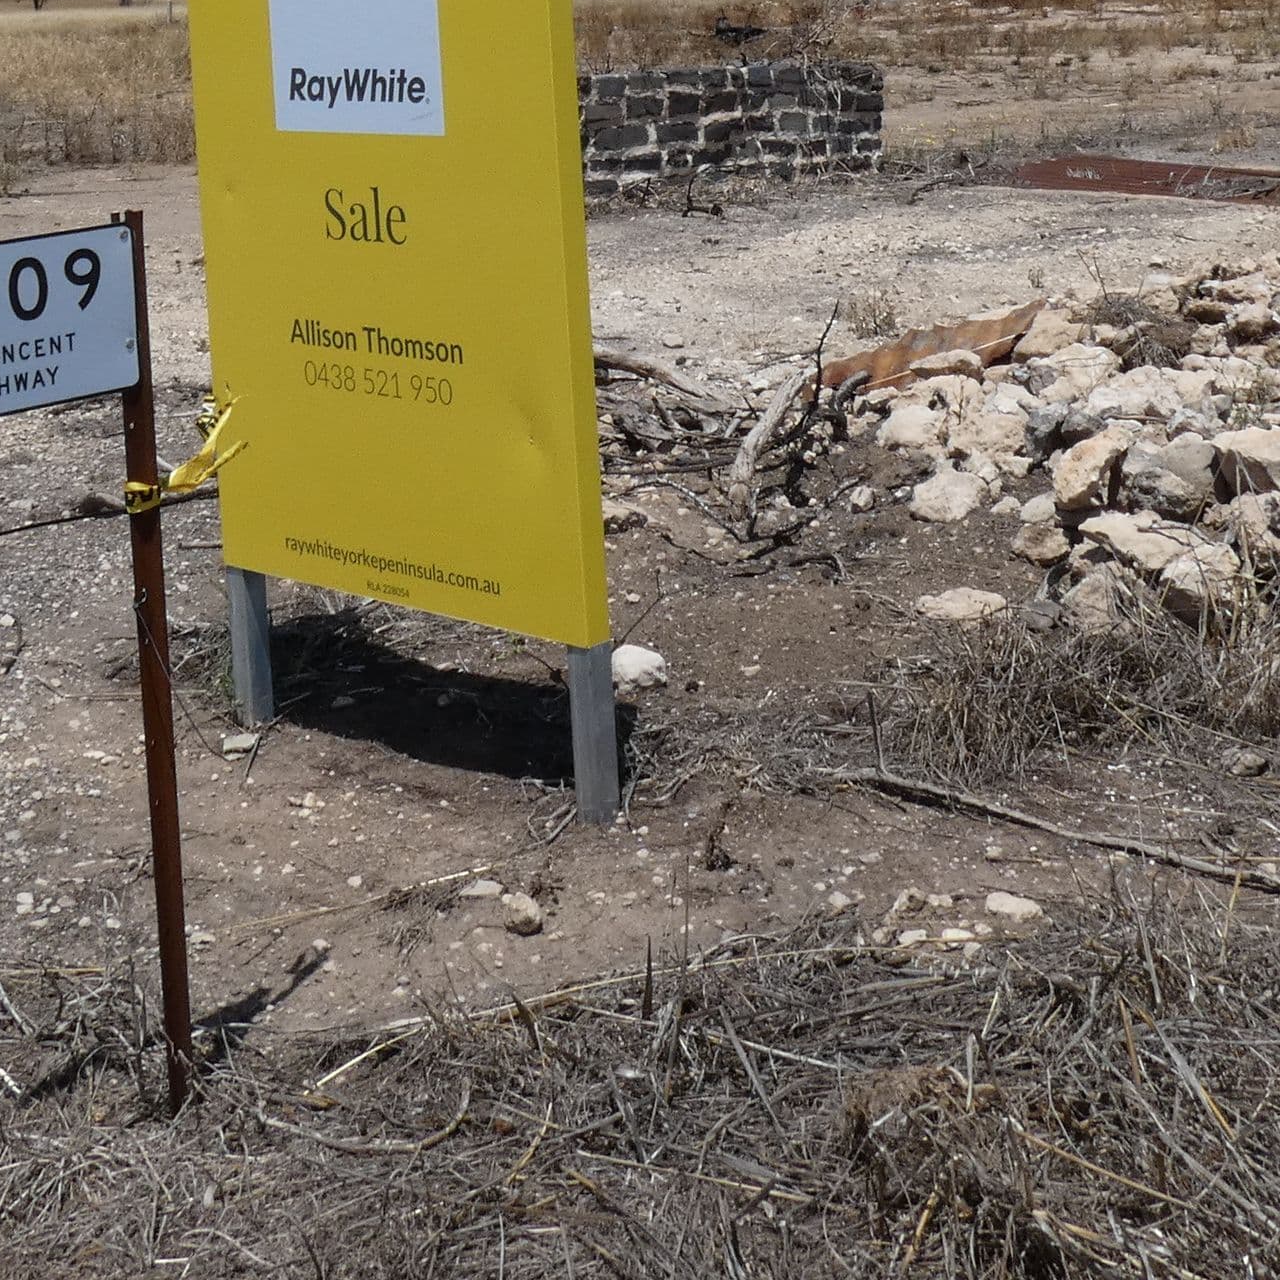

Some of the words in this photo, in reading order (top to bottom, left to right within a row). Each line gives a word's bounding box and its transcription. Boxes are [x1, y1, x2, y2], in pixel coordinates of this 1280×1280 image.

[324, 186, 407, 245] Sale
[290, 319, 357, 352] Allison
[362, 326, 464, 364] Thomson
[304, 360, 356, 392] 0438
[363, 368, 402, 399] 521
[410, 374, 453, 406] 950
[285, 536, 501, 596] raywhiteyorkepeninsula.com.au
